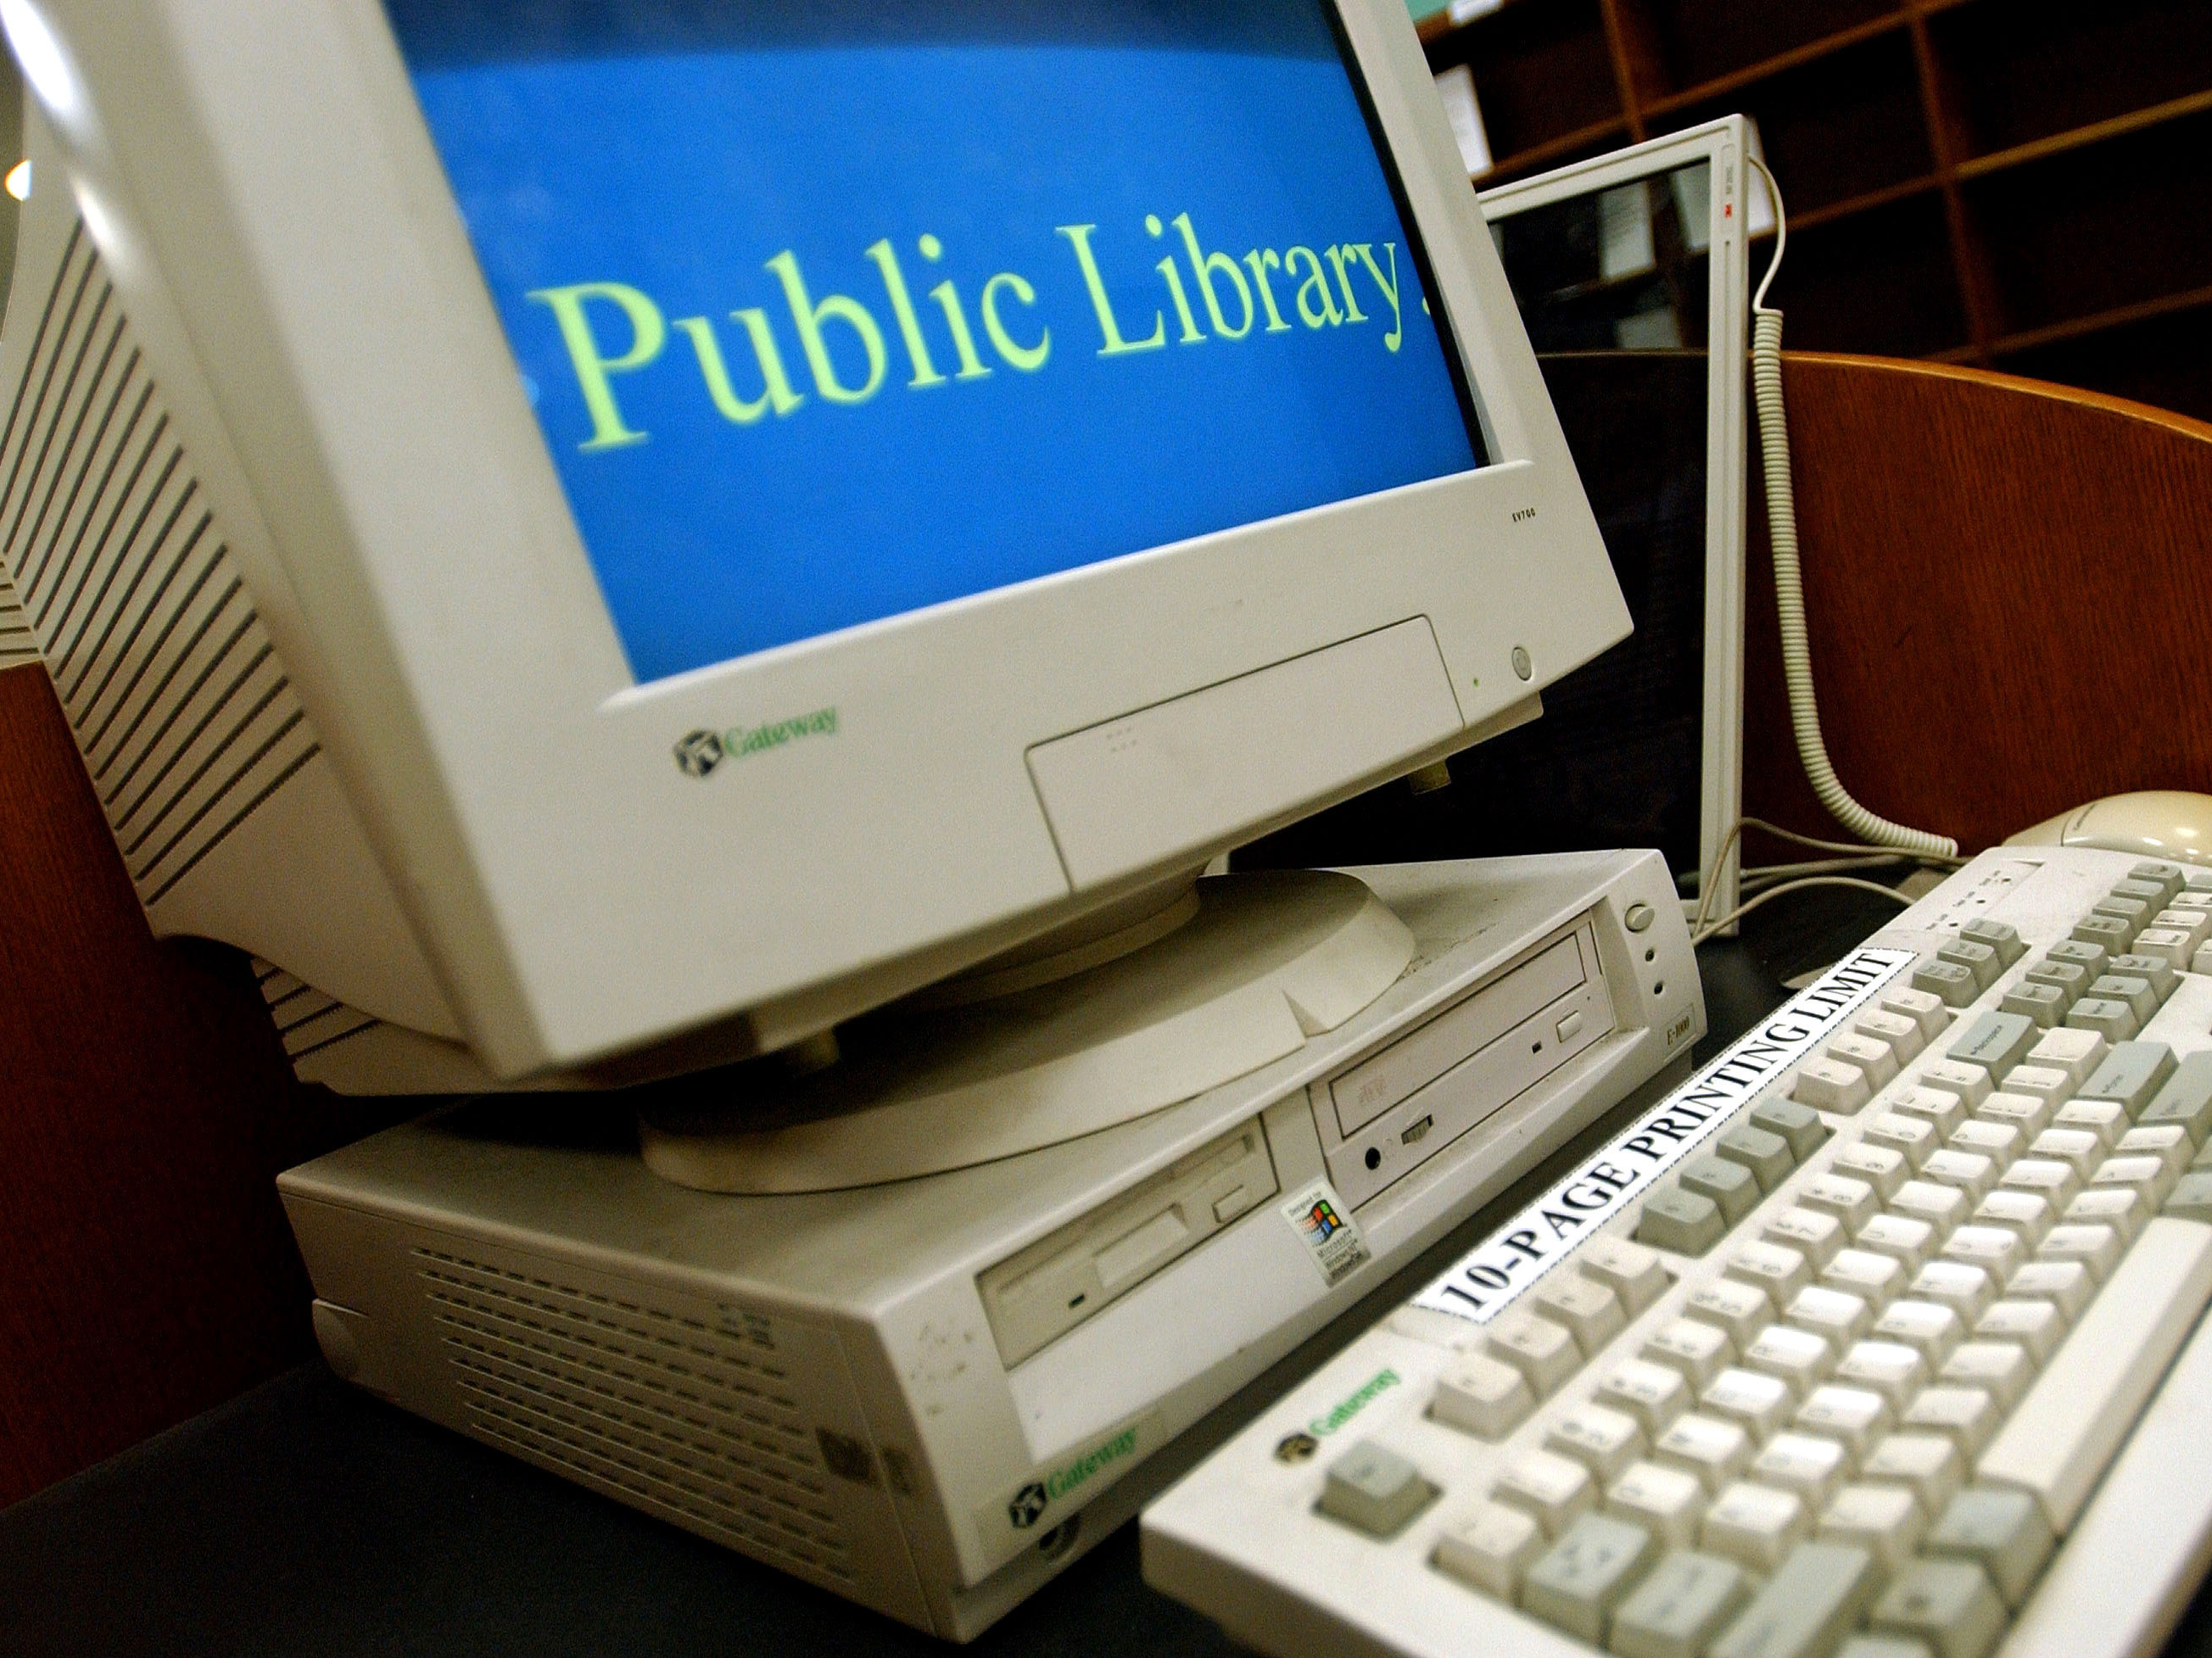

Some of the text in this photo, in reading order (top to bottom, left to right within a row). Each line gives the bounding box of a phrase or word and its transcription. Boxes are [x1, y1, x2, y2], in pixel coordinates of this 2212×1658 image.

[525, 213, 1401, 450] Public Library
[1511, 507, 1536, 522] EV700
[724, 706, 838, 757] Gateway
[1667, 1015, 1690, 1046] E-1000
[1441, 952, 1895, 1311] 10-PAGE PRINTING LIMIT
[1310, 1368, 1401, 1436] Gateway
[1047, 1427, 1137, 1499] Gateway
